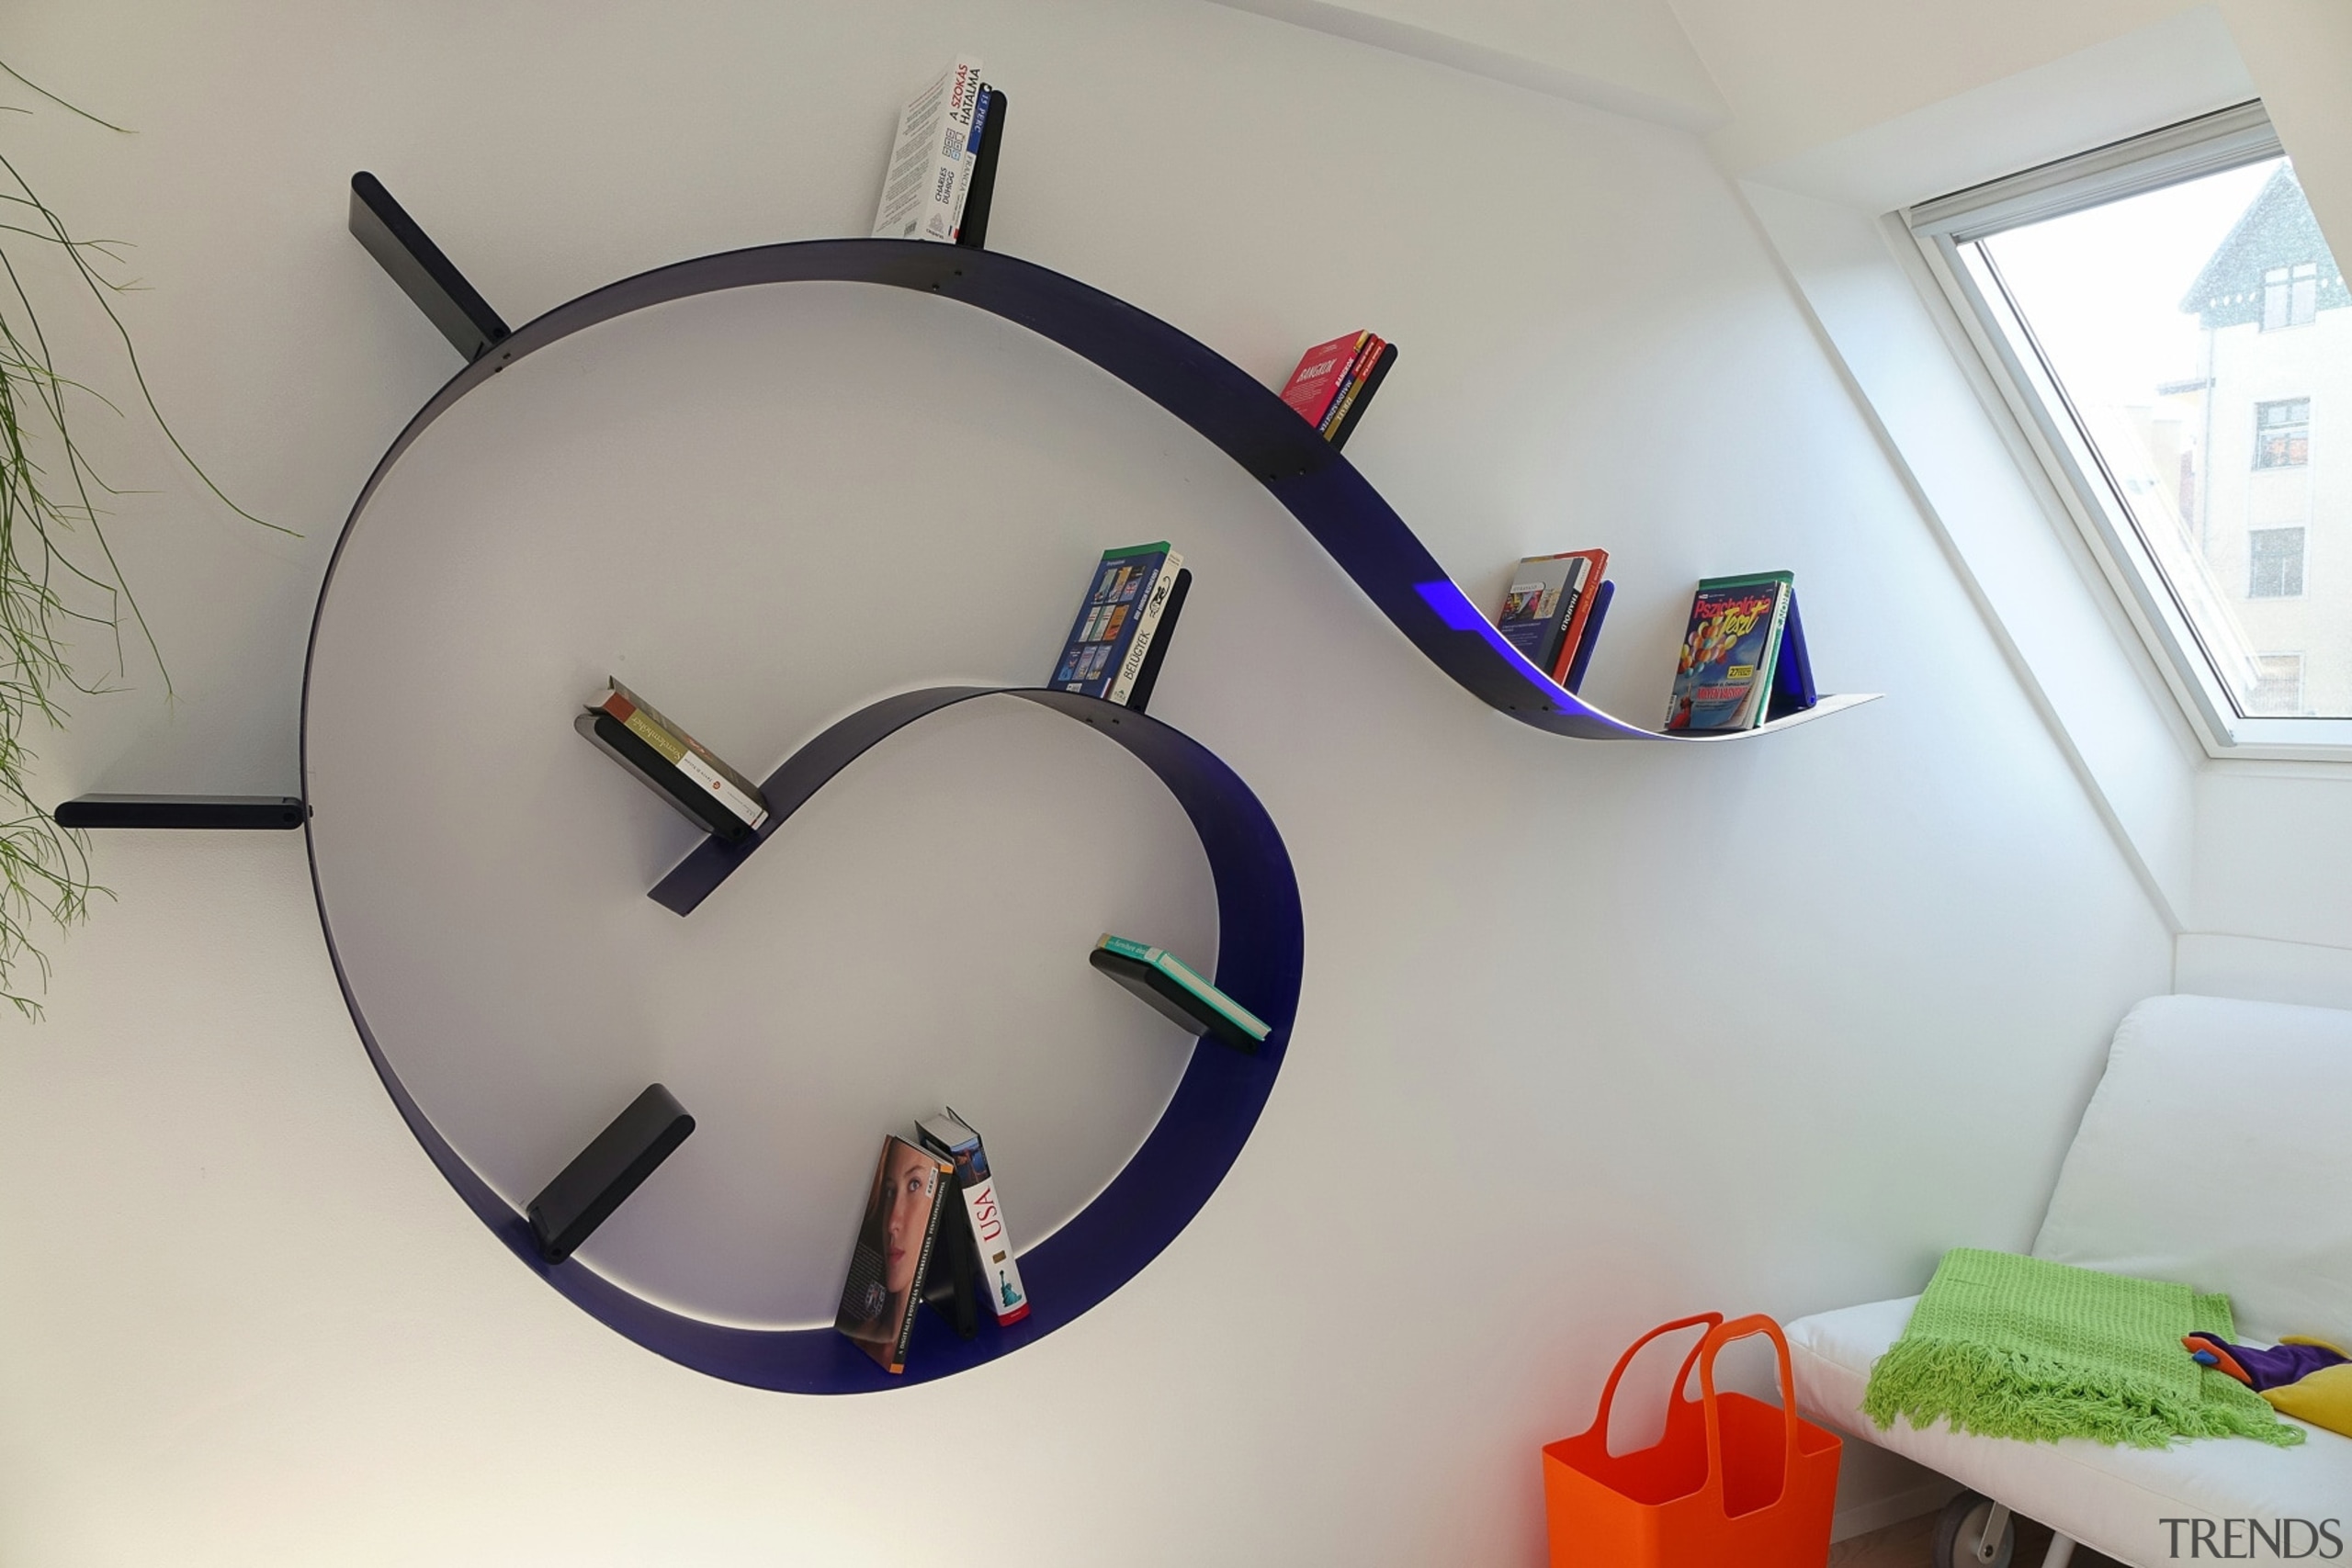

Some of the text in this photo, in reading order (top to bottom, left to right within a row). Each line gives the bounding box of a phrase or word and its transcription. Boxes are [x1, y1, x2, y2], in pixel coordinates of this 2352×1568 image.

[949, 63, 967, 120] A SZOKÁS
[959, 69, 980, 125] HATALMA
[974, 107, 986, 133] PERC
[935, 167, 947, 202] CHARLES
[1335, 357, 1354, 388] BANGKOK
[973, 1187, 1002, 1242] USA
